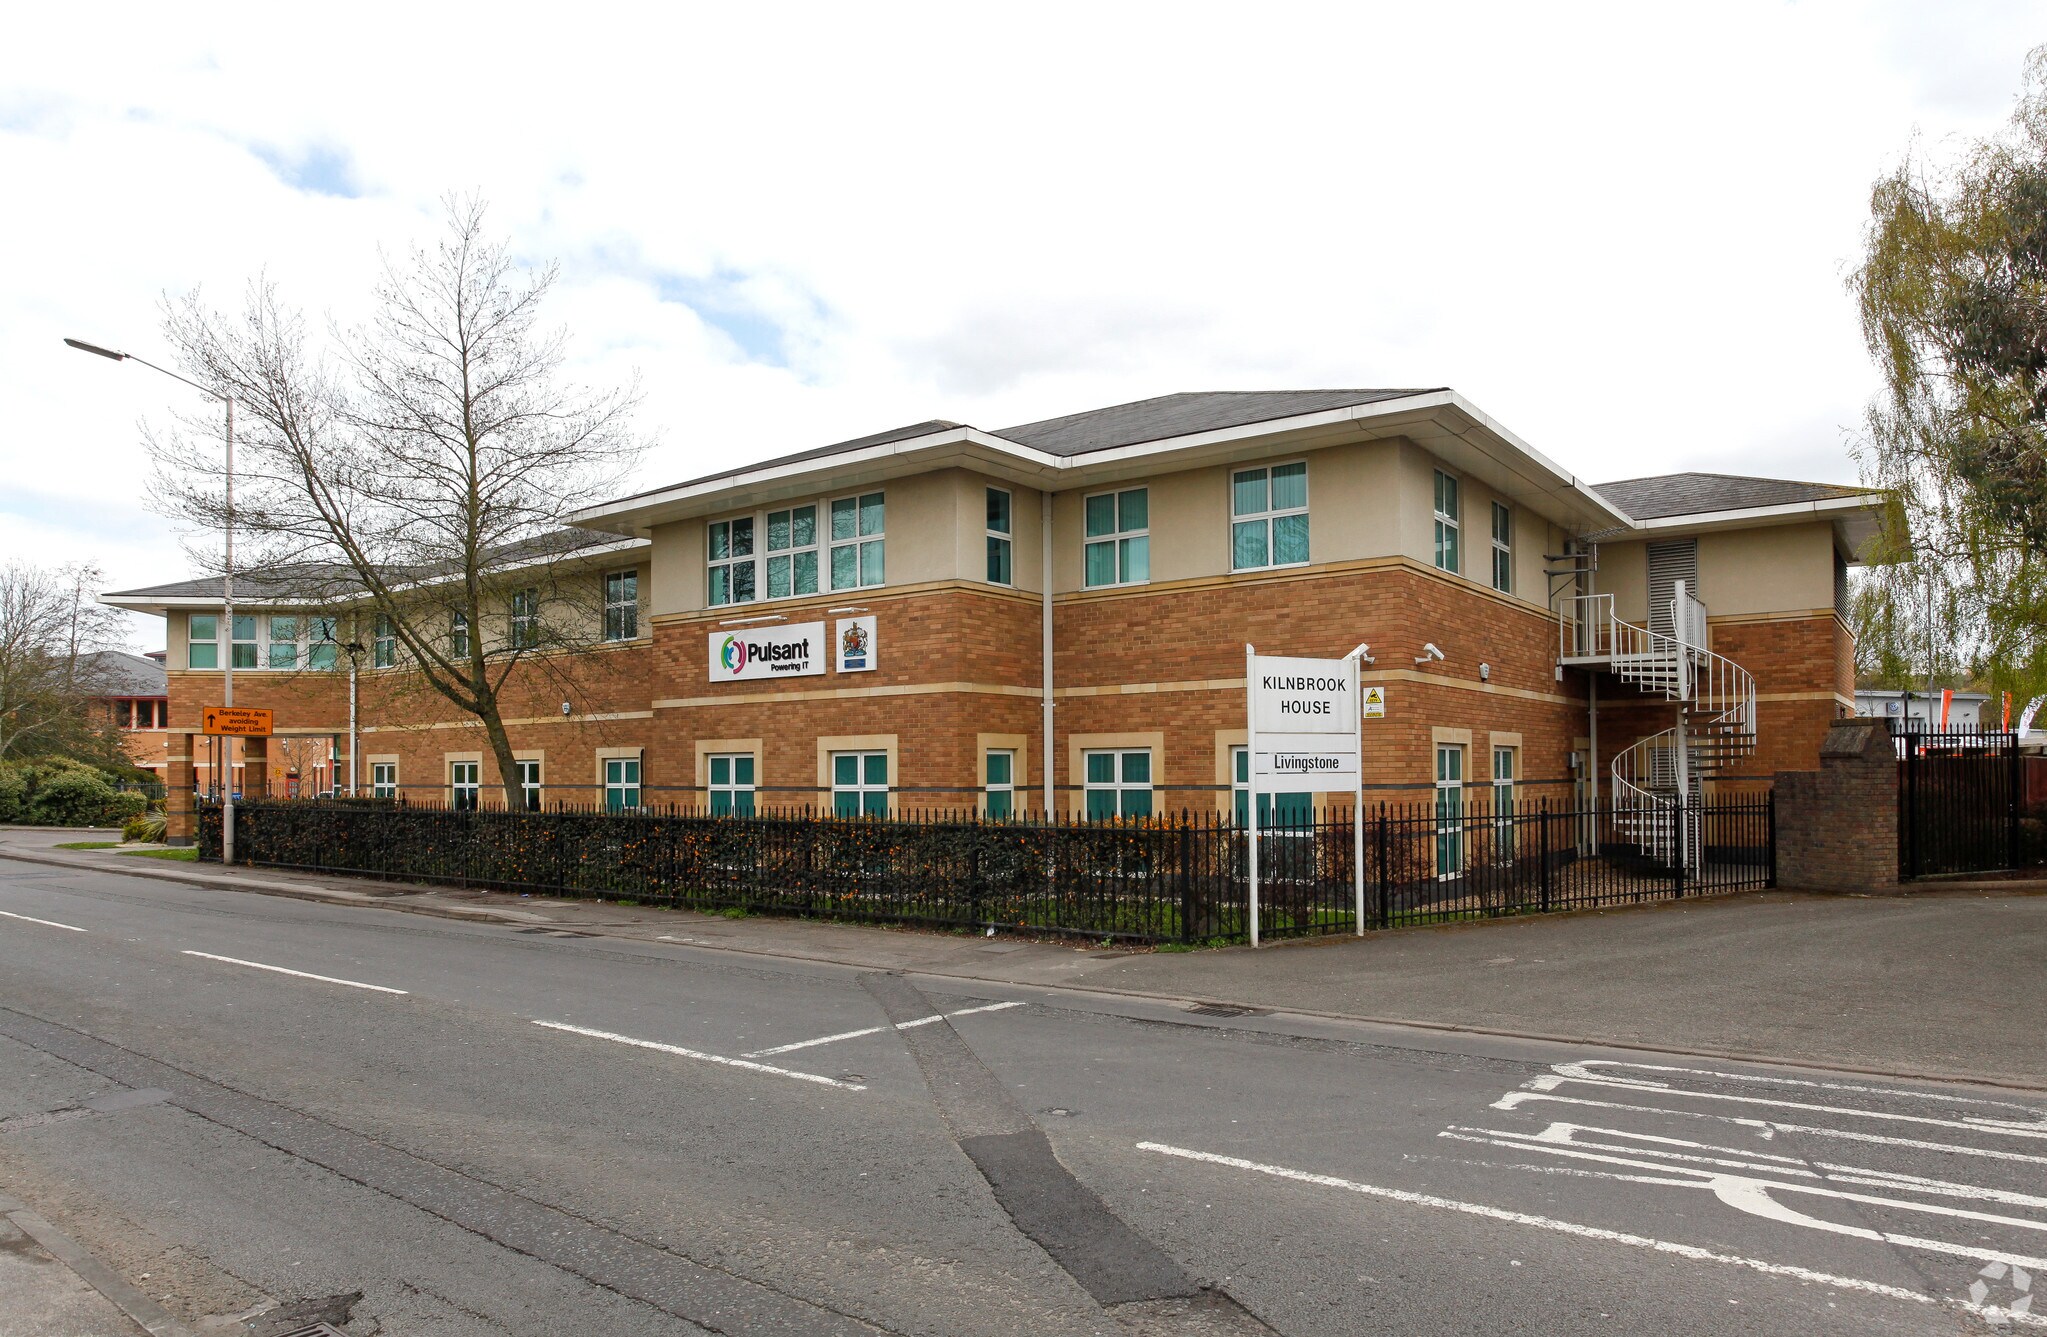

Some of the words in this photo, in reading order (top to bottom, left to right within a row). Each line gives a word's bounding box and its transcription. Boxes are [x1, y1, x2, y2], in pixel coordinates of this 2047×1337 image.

[748, 638, 809, 662] Pulsant
[771, 662, 801, 672] Powering
[802, 661, 809, 669] IT
[1263, 676, 1347, 692] KILNBROOK
[1281, 700, 1331, 714] HOUSE
[221, 725, 246, 733] Weight
[229, 718, 259, 726] avoiding
[1274, 754, 1339, 772] Livingstone
